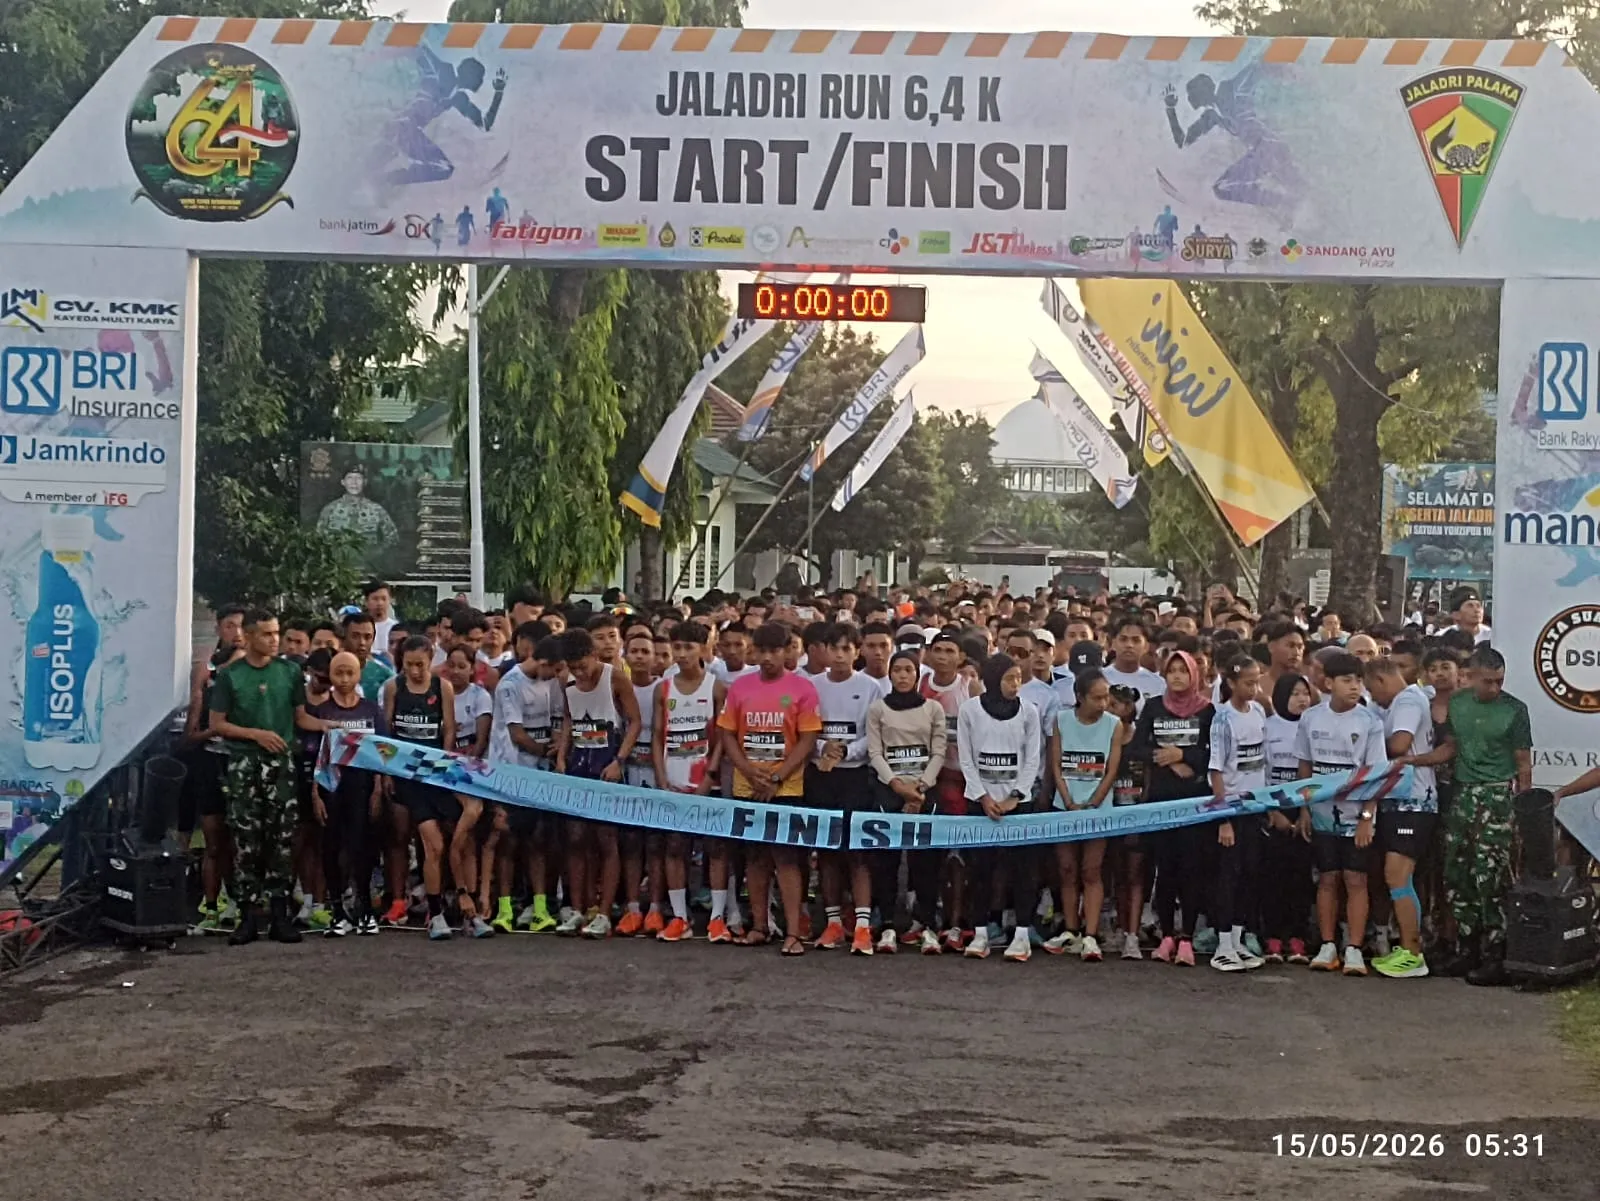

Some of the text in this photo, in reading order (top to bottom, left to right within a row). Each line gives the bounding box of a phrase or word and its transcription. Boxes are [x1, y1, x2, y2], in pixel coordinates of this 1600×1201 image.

[656, 71, 1001, 126] JALADRI RUN 6,4 K
[1406, 75, 1520, 102] JALADRI PALAKA
[319, 218, 379, 231] bankjatim
[490, 220, 583, 244] fatigon
[961, 232, 1016, 253] J&T
[1181, 236, 1232, 261] SURYA
[1306, 246, 1396, 258] SANDANG AYU
[54, 300, 180, 316] CV. KMK
[755, 286, 889, 317] 0:00:00
[100, 316, 135, 324] MULTI
[137, 317, 175, 325] KARYA
[72, 350, 137, 390] BRI
[861, 368, 889, 400] BRI
[71, 396, 180, 419] Insurance
[1538, 430, 1568, 447] Bank
[22, 437, 166, 464] Jamkrindo
[25, 491, 33, 500] A
[35, 491, 83, 503] member
[85, 492, 98, 503] of
[1407, 491, 1479, 507] SELAMAT
[1395, 507, 1447, 522] SERTA
[1504, 512, 1600, 546] man
[50, 603, 74, 720] ISOPLUS
[746, 711, 785, 727] BATAM
[1533, 750, 1578, 767] JASA
[492, 773, 595, 810] JALADRI
